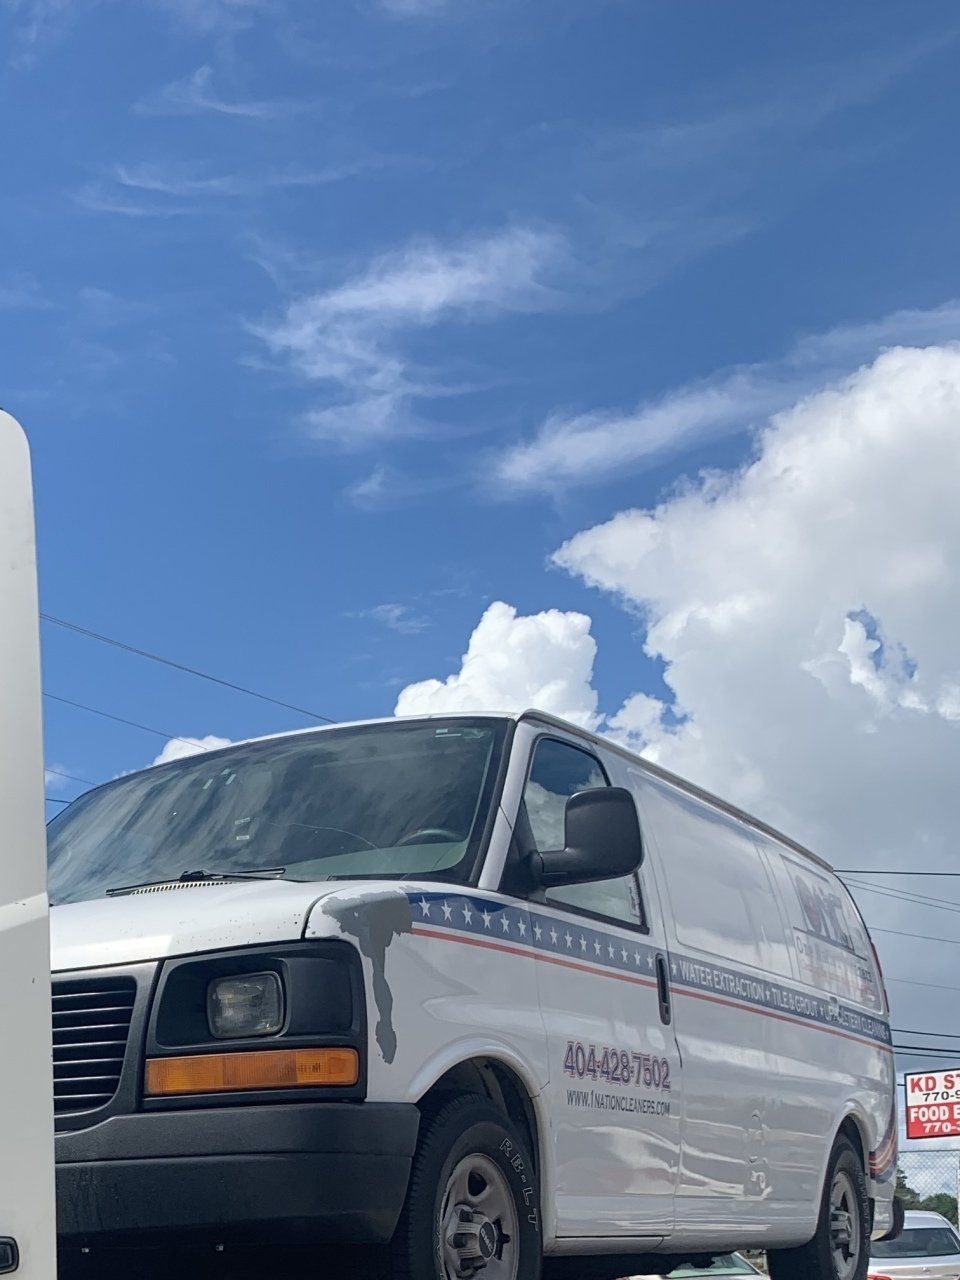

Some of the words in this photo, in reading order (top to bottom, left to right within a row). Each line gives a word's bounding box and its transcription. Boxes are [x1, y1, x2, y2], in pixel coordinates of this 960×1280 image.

[679, 961, 713, 988] WATER
[713, 969, 765, 1002] EXTRACTION
[772, 988, 789, 1008] TILE
[795, 996, 818, 1017] GROUT
[564, 1041, 671, 1093] 404-428-7502
[910, 1076, 937, 1093] KD
[910, 1105, 950, 1123] FOOD
